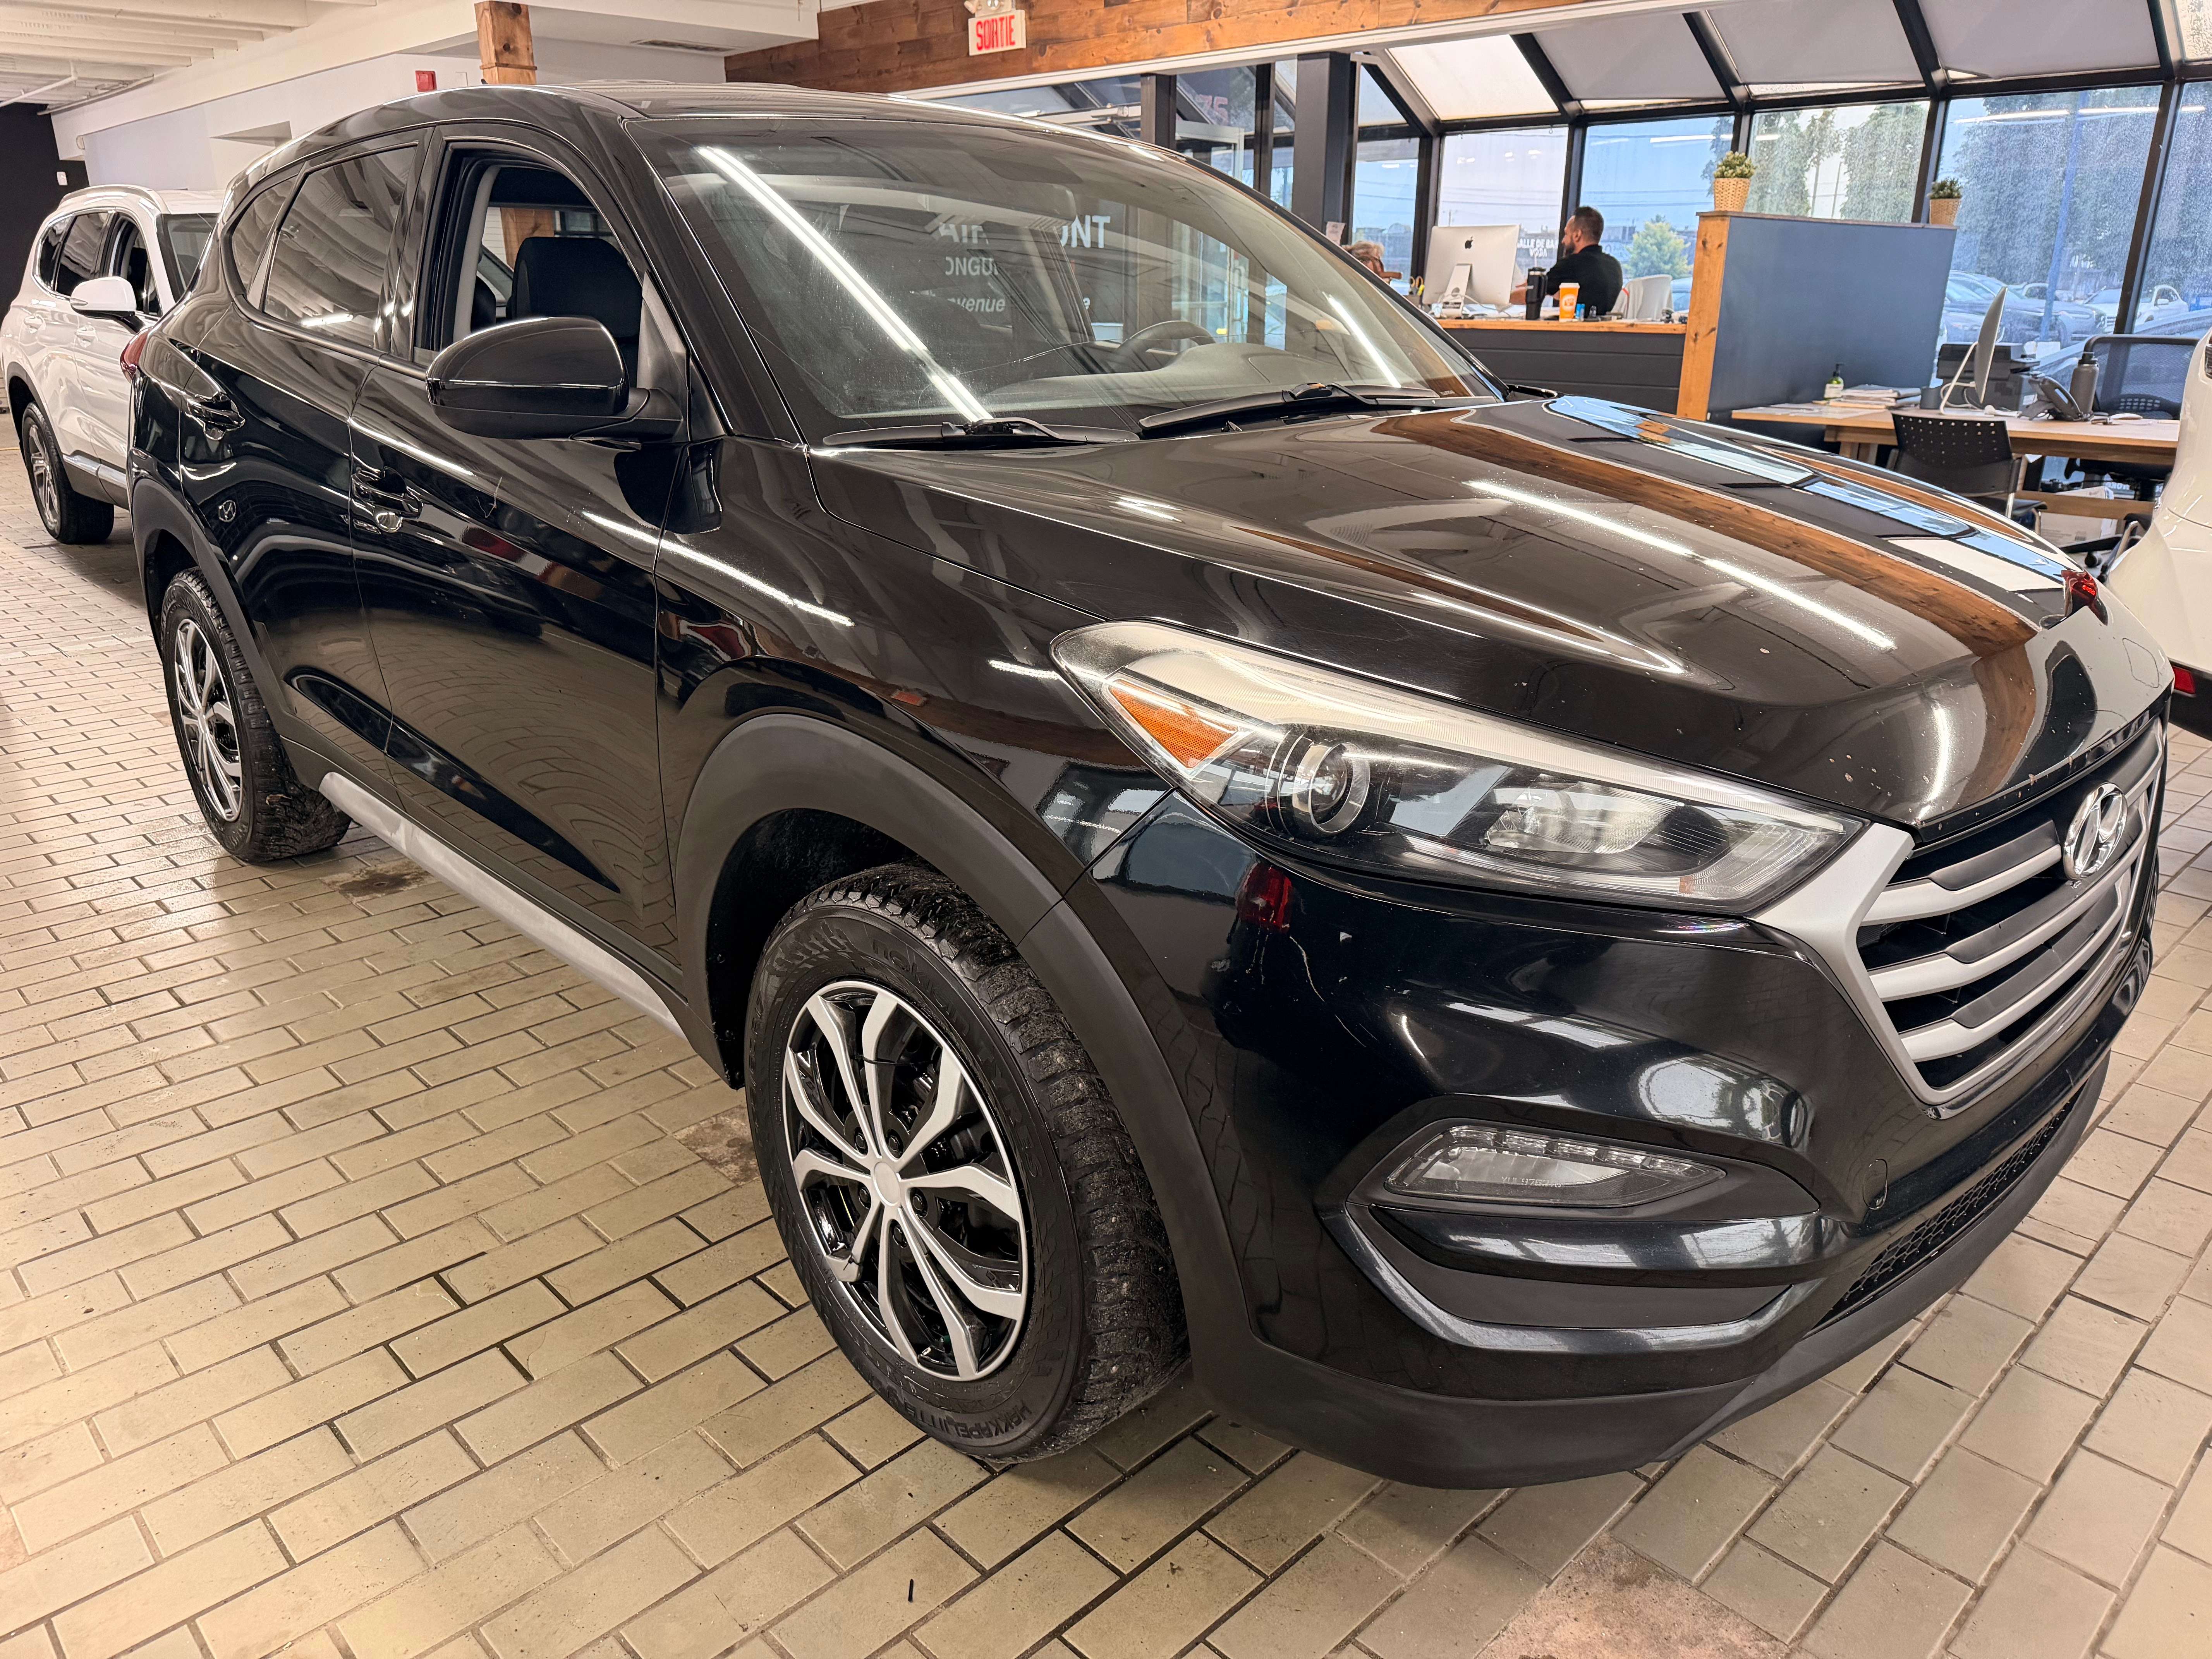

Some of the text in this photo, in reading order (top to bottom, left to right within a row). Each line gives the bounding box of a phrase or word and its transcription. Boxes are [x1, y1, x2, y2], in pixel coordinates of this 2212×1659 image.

[975, 15, 1015, 51] SORTIE
[1517, 238, 1535, 248] ALLE
[945, 256, 999, 276] ONGU
[948, 297, 1006, 312] venue
